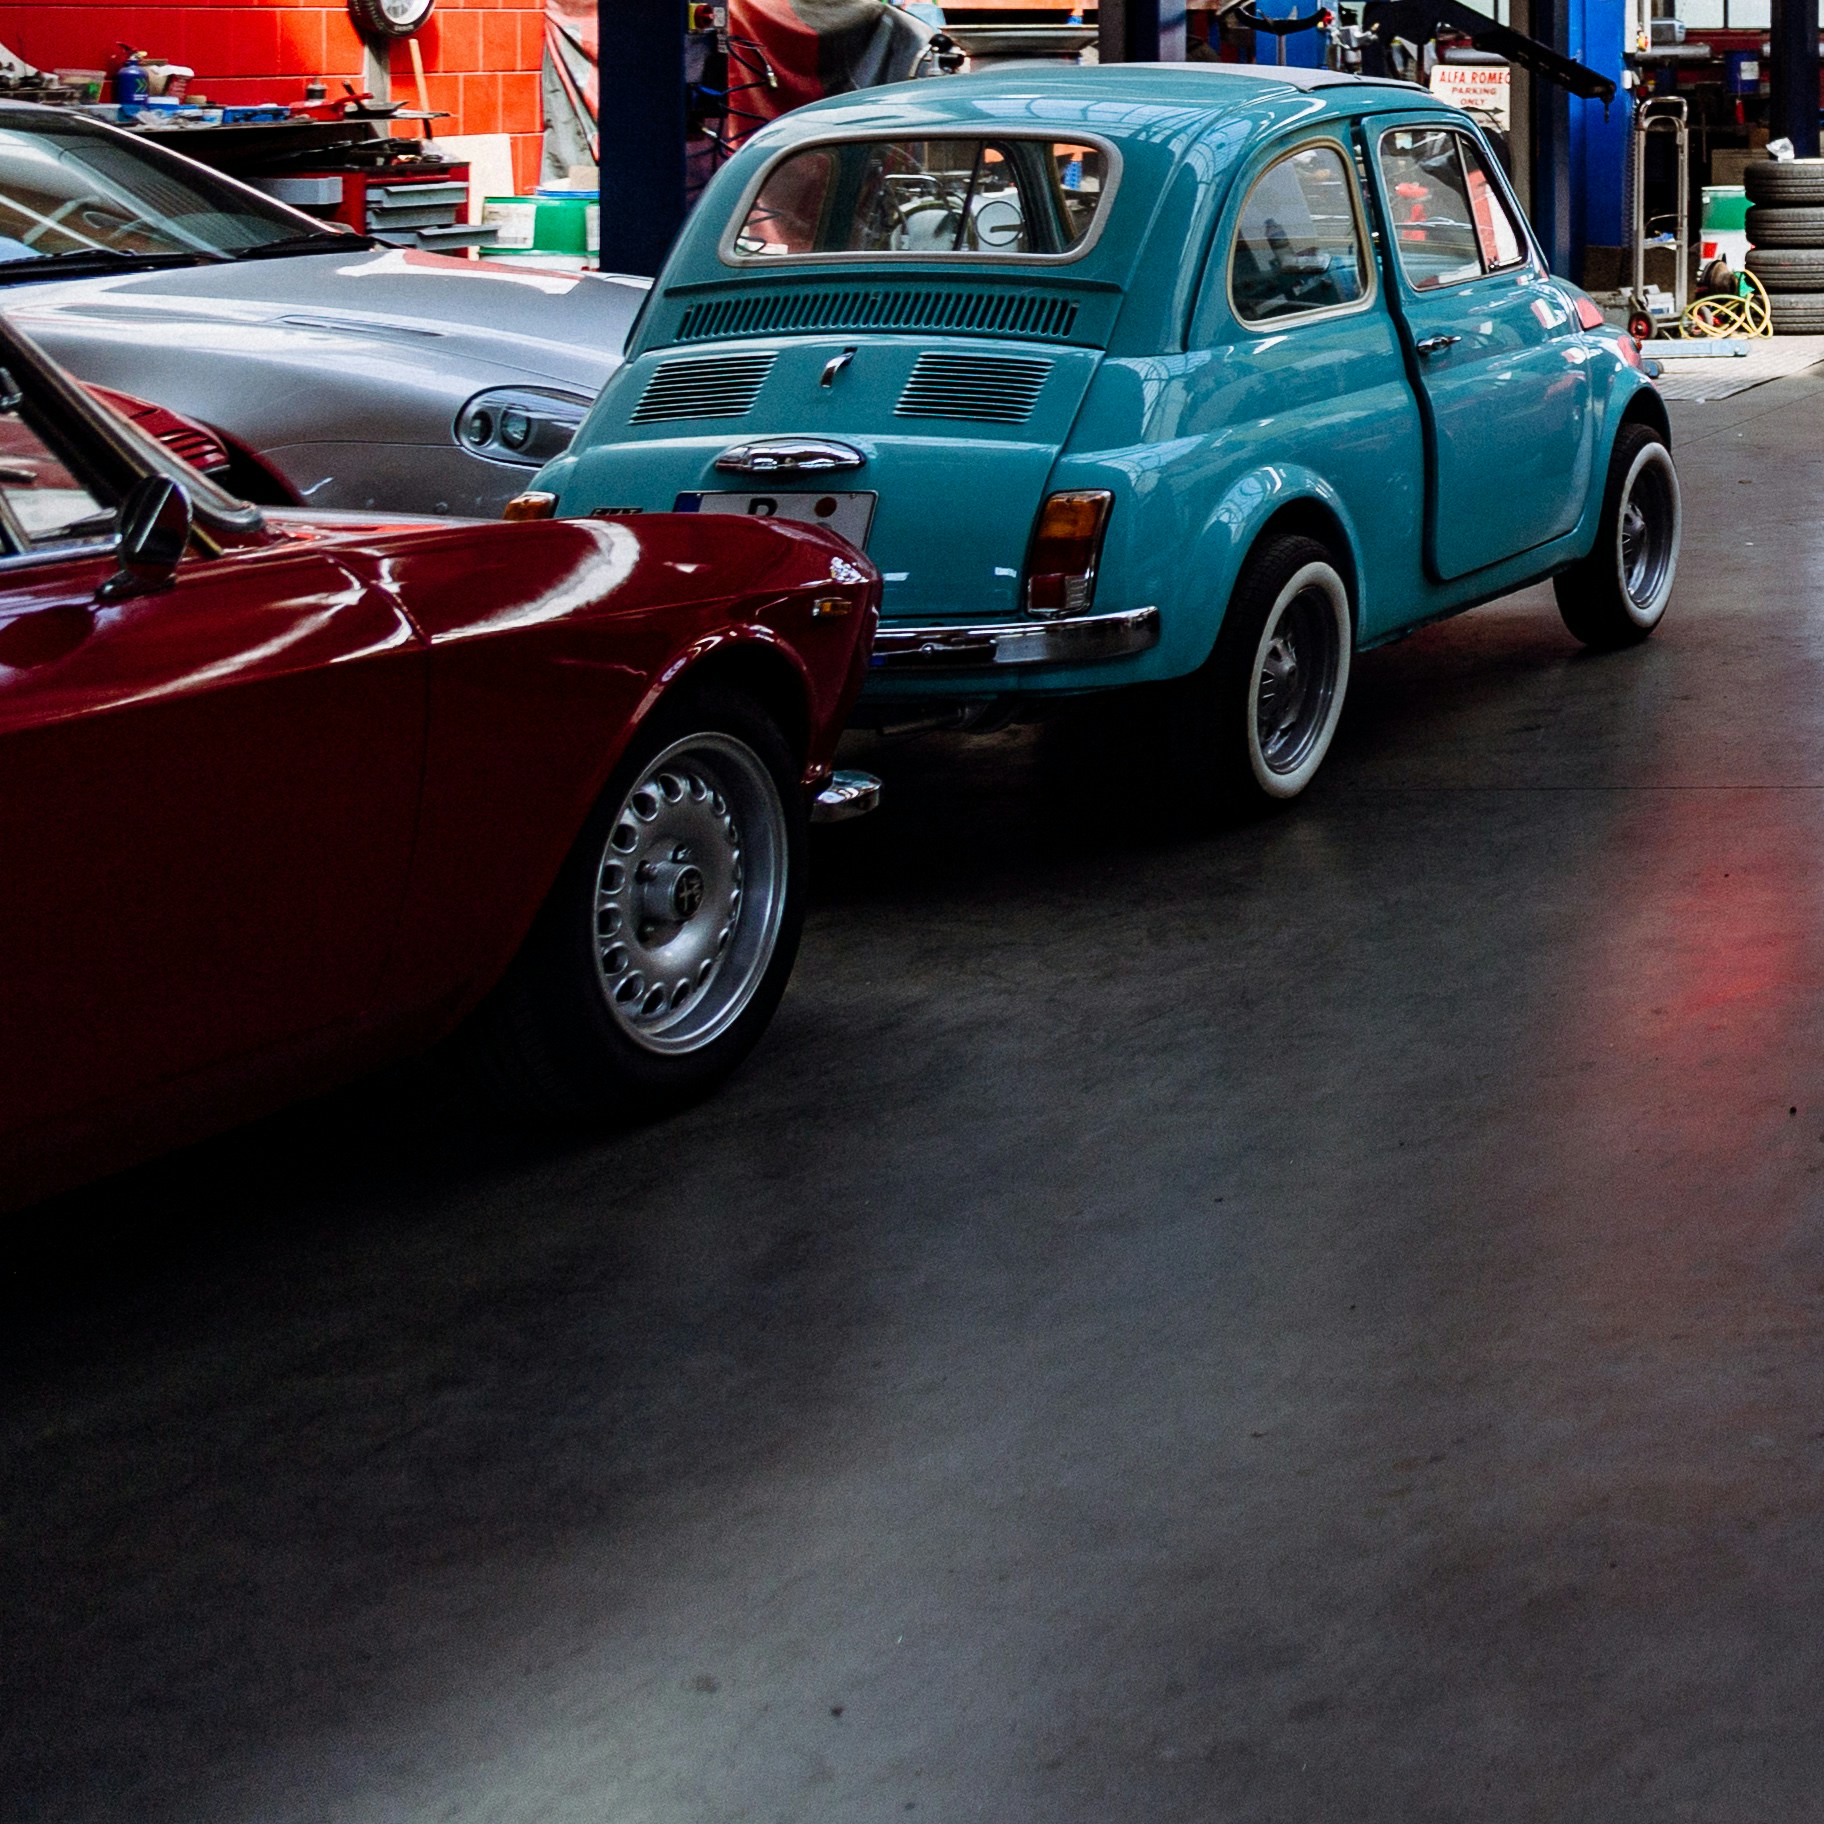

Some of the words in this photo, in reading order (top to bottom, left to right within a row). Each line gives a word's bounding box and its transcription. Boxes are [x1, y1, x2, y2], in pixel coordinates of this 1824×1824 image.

[1439, 71, 1466, 84] ALFA
[1451, 86, 1497, 95] PARKING
[1460, 98, 1486, 106] ONLY
